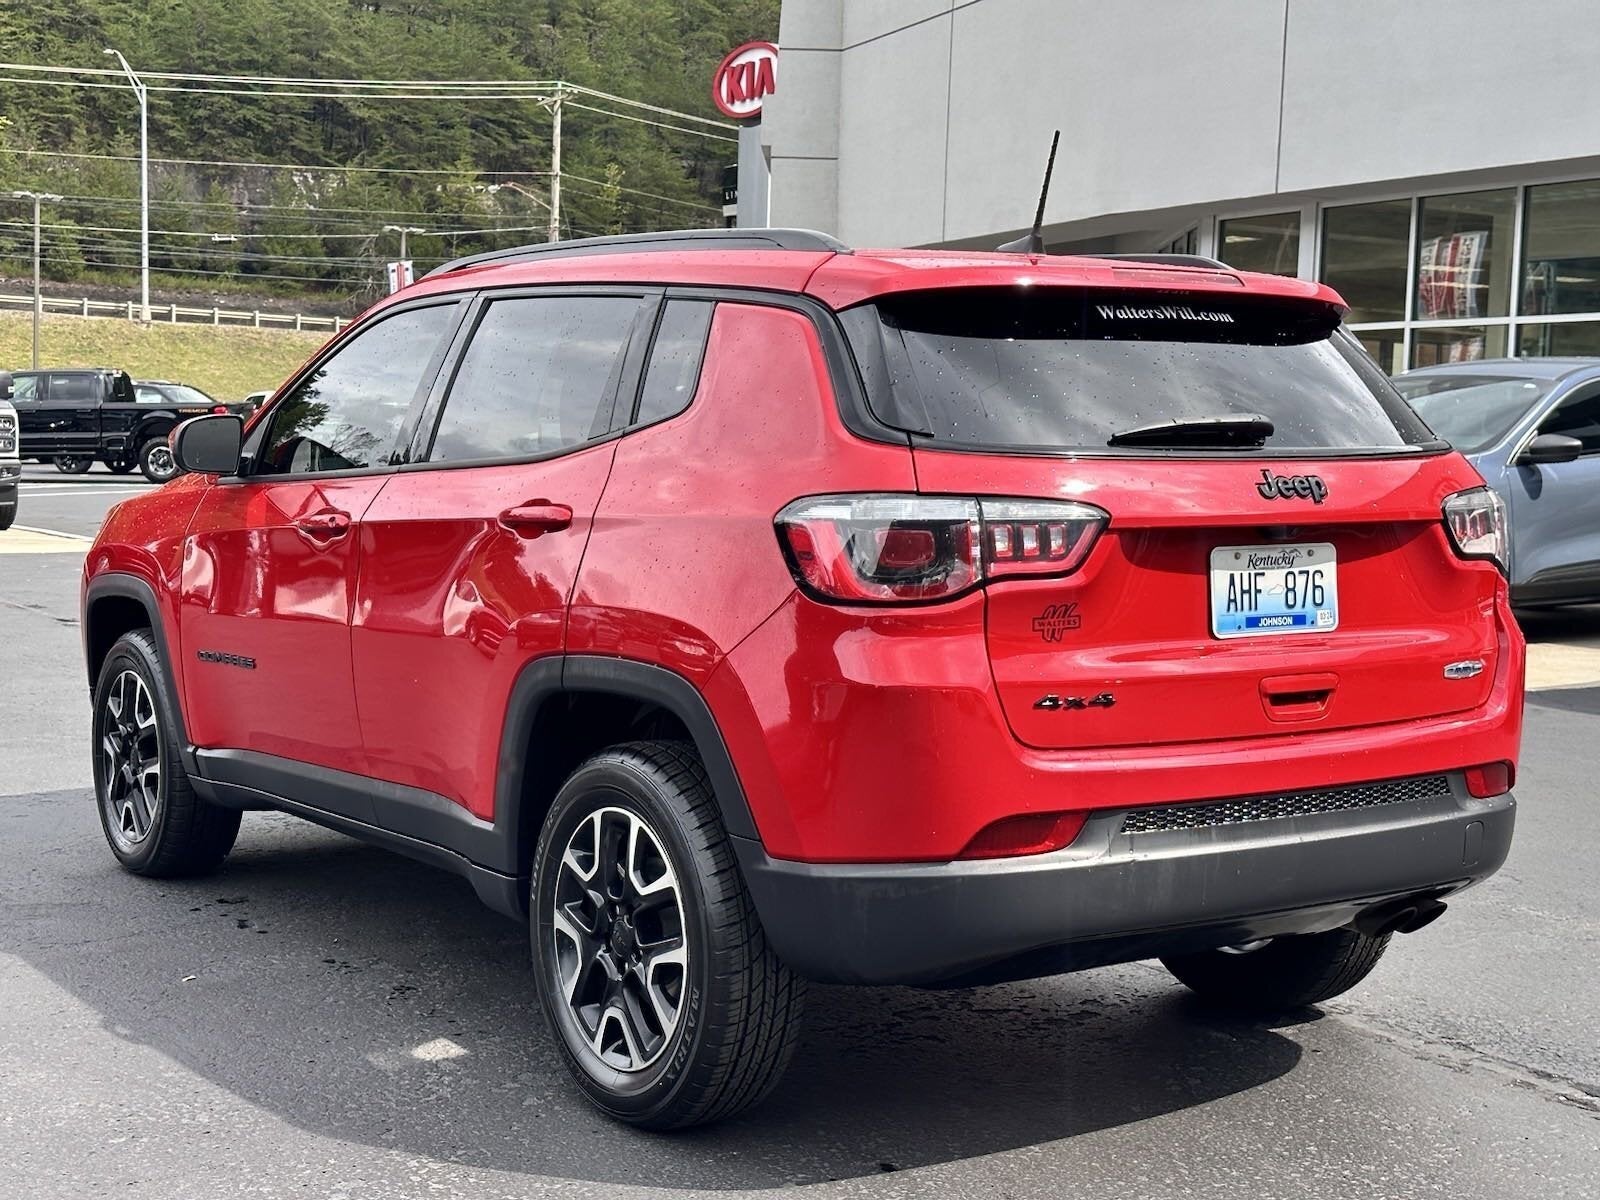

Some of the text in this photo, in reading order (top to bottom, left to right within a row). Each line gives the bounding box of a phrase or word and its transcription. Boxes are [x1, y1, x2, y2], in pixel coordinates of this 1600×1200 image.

[726, 57, 775, 104] KIA
[1095, 305, 1235, 323] WaltersWill.com
[1255, 469, 1328, 504] Jeep
[1247, 552, 1295, 570] Kentucky
[1226, 569, 1325, 613] AHF 876
[1037, 618, 1078, 628] WALTERS
[1258, 616, 1293, 627] JOHNSON
[666, 987, 700, 1080] MATRIX
